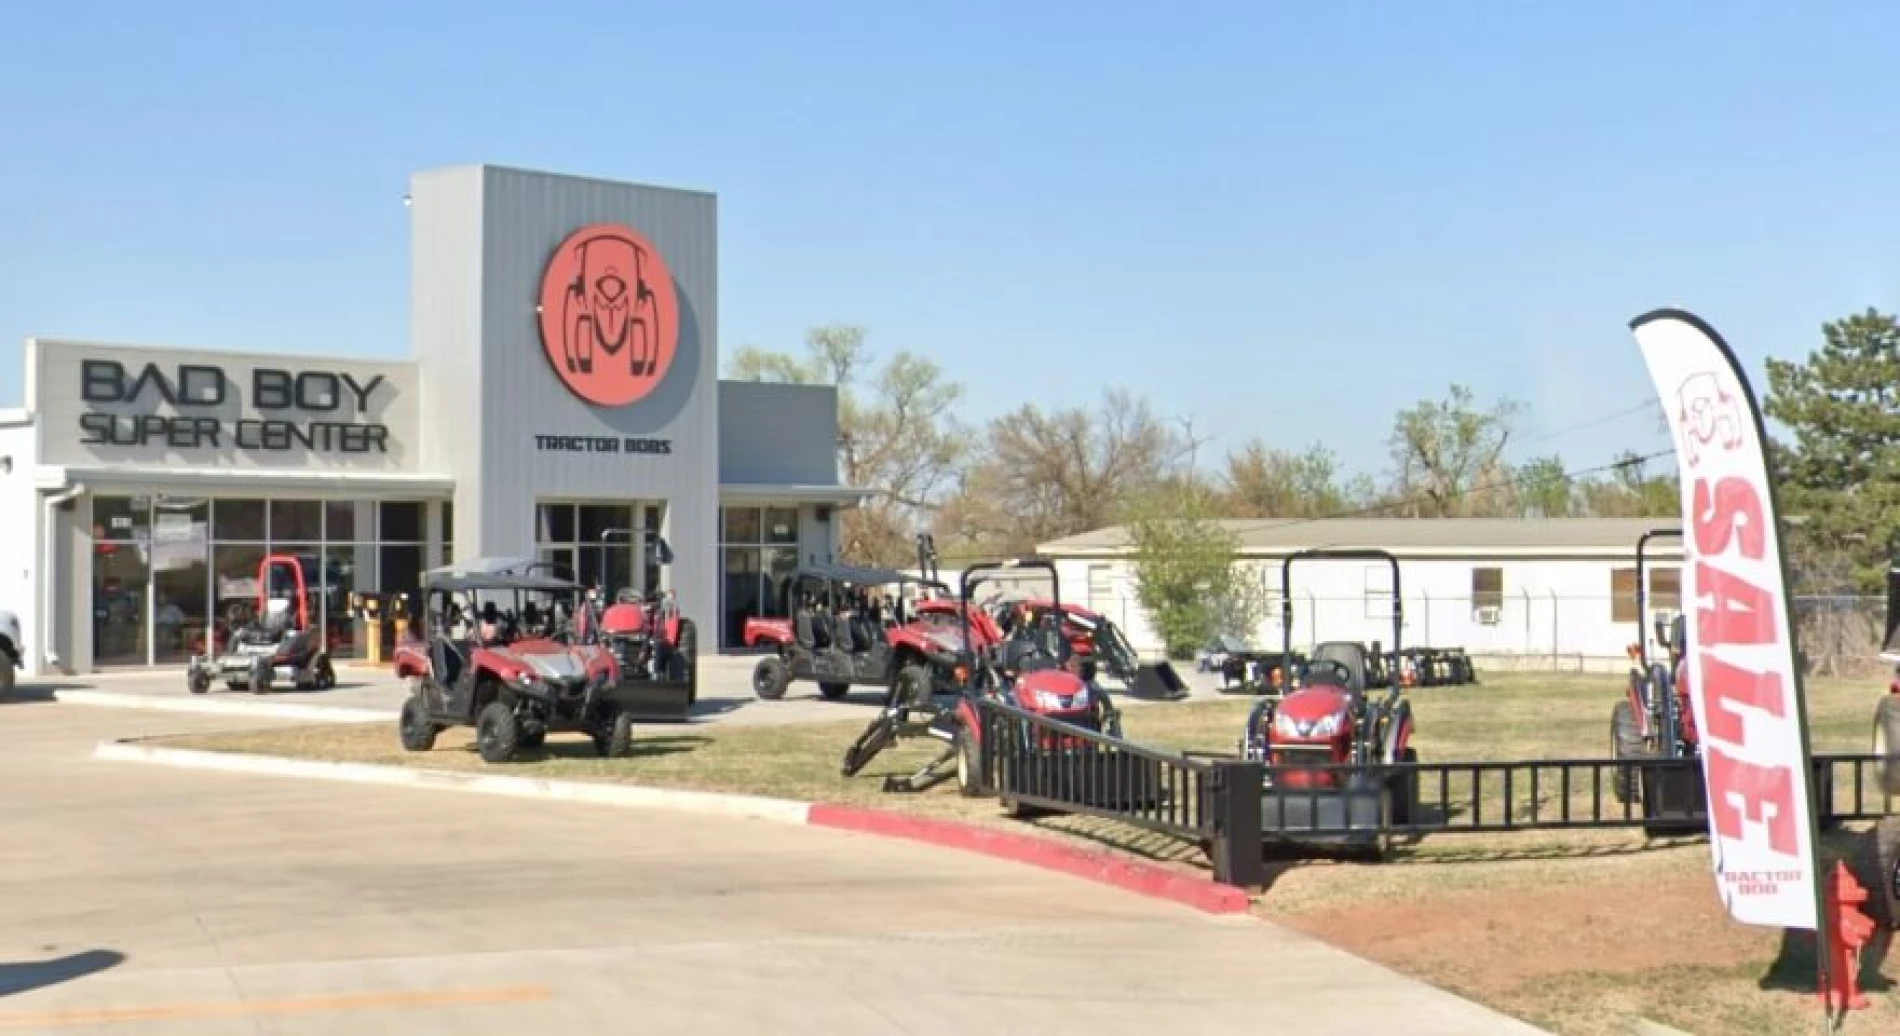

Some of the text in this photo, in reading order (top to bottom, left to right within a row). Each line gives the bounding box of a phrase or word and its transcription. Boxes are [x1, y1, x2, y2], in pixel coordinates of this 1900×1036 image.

[81, 359, 385, 413] BAD BOY
[79, 413, 388, 453] SUPER CENTER
[535, 435, 672, 454] TRACTOR BOBS
[1694, 475, 1800, 858] SALE
[1724, 871, 1802, 882] RACTOR
